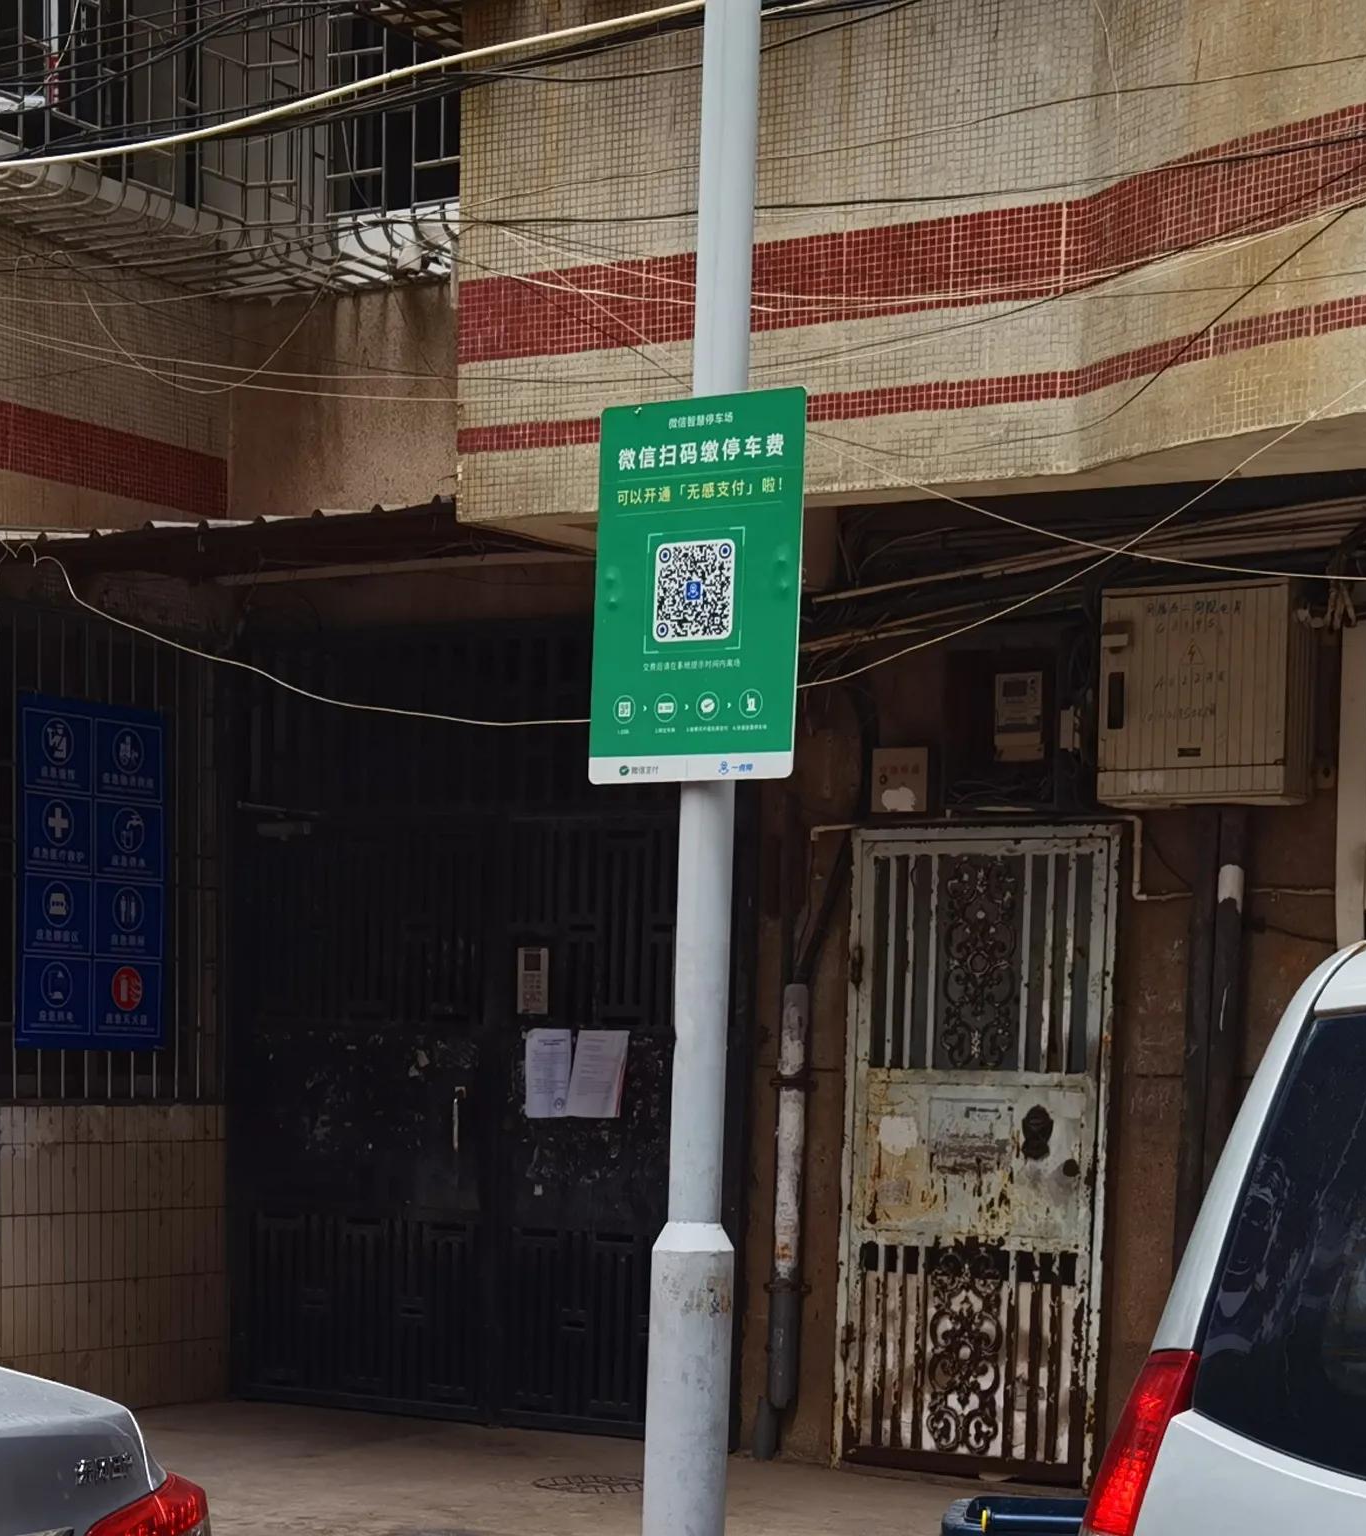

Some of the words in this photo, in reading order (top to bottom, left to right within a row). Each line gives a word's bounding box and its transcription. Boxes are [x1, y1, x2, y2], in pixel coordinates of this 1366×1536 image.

[668, 411, 734, 430] 微信智慧停车场
[618, 433, 785, 470] 微信扫码缴停车费
